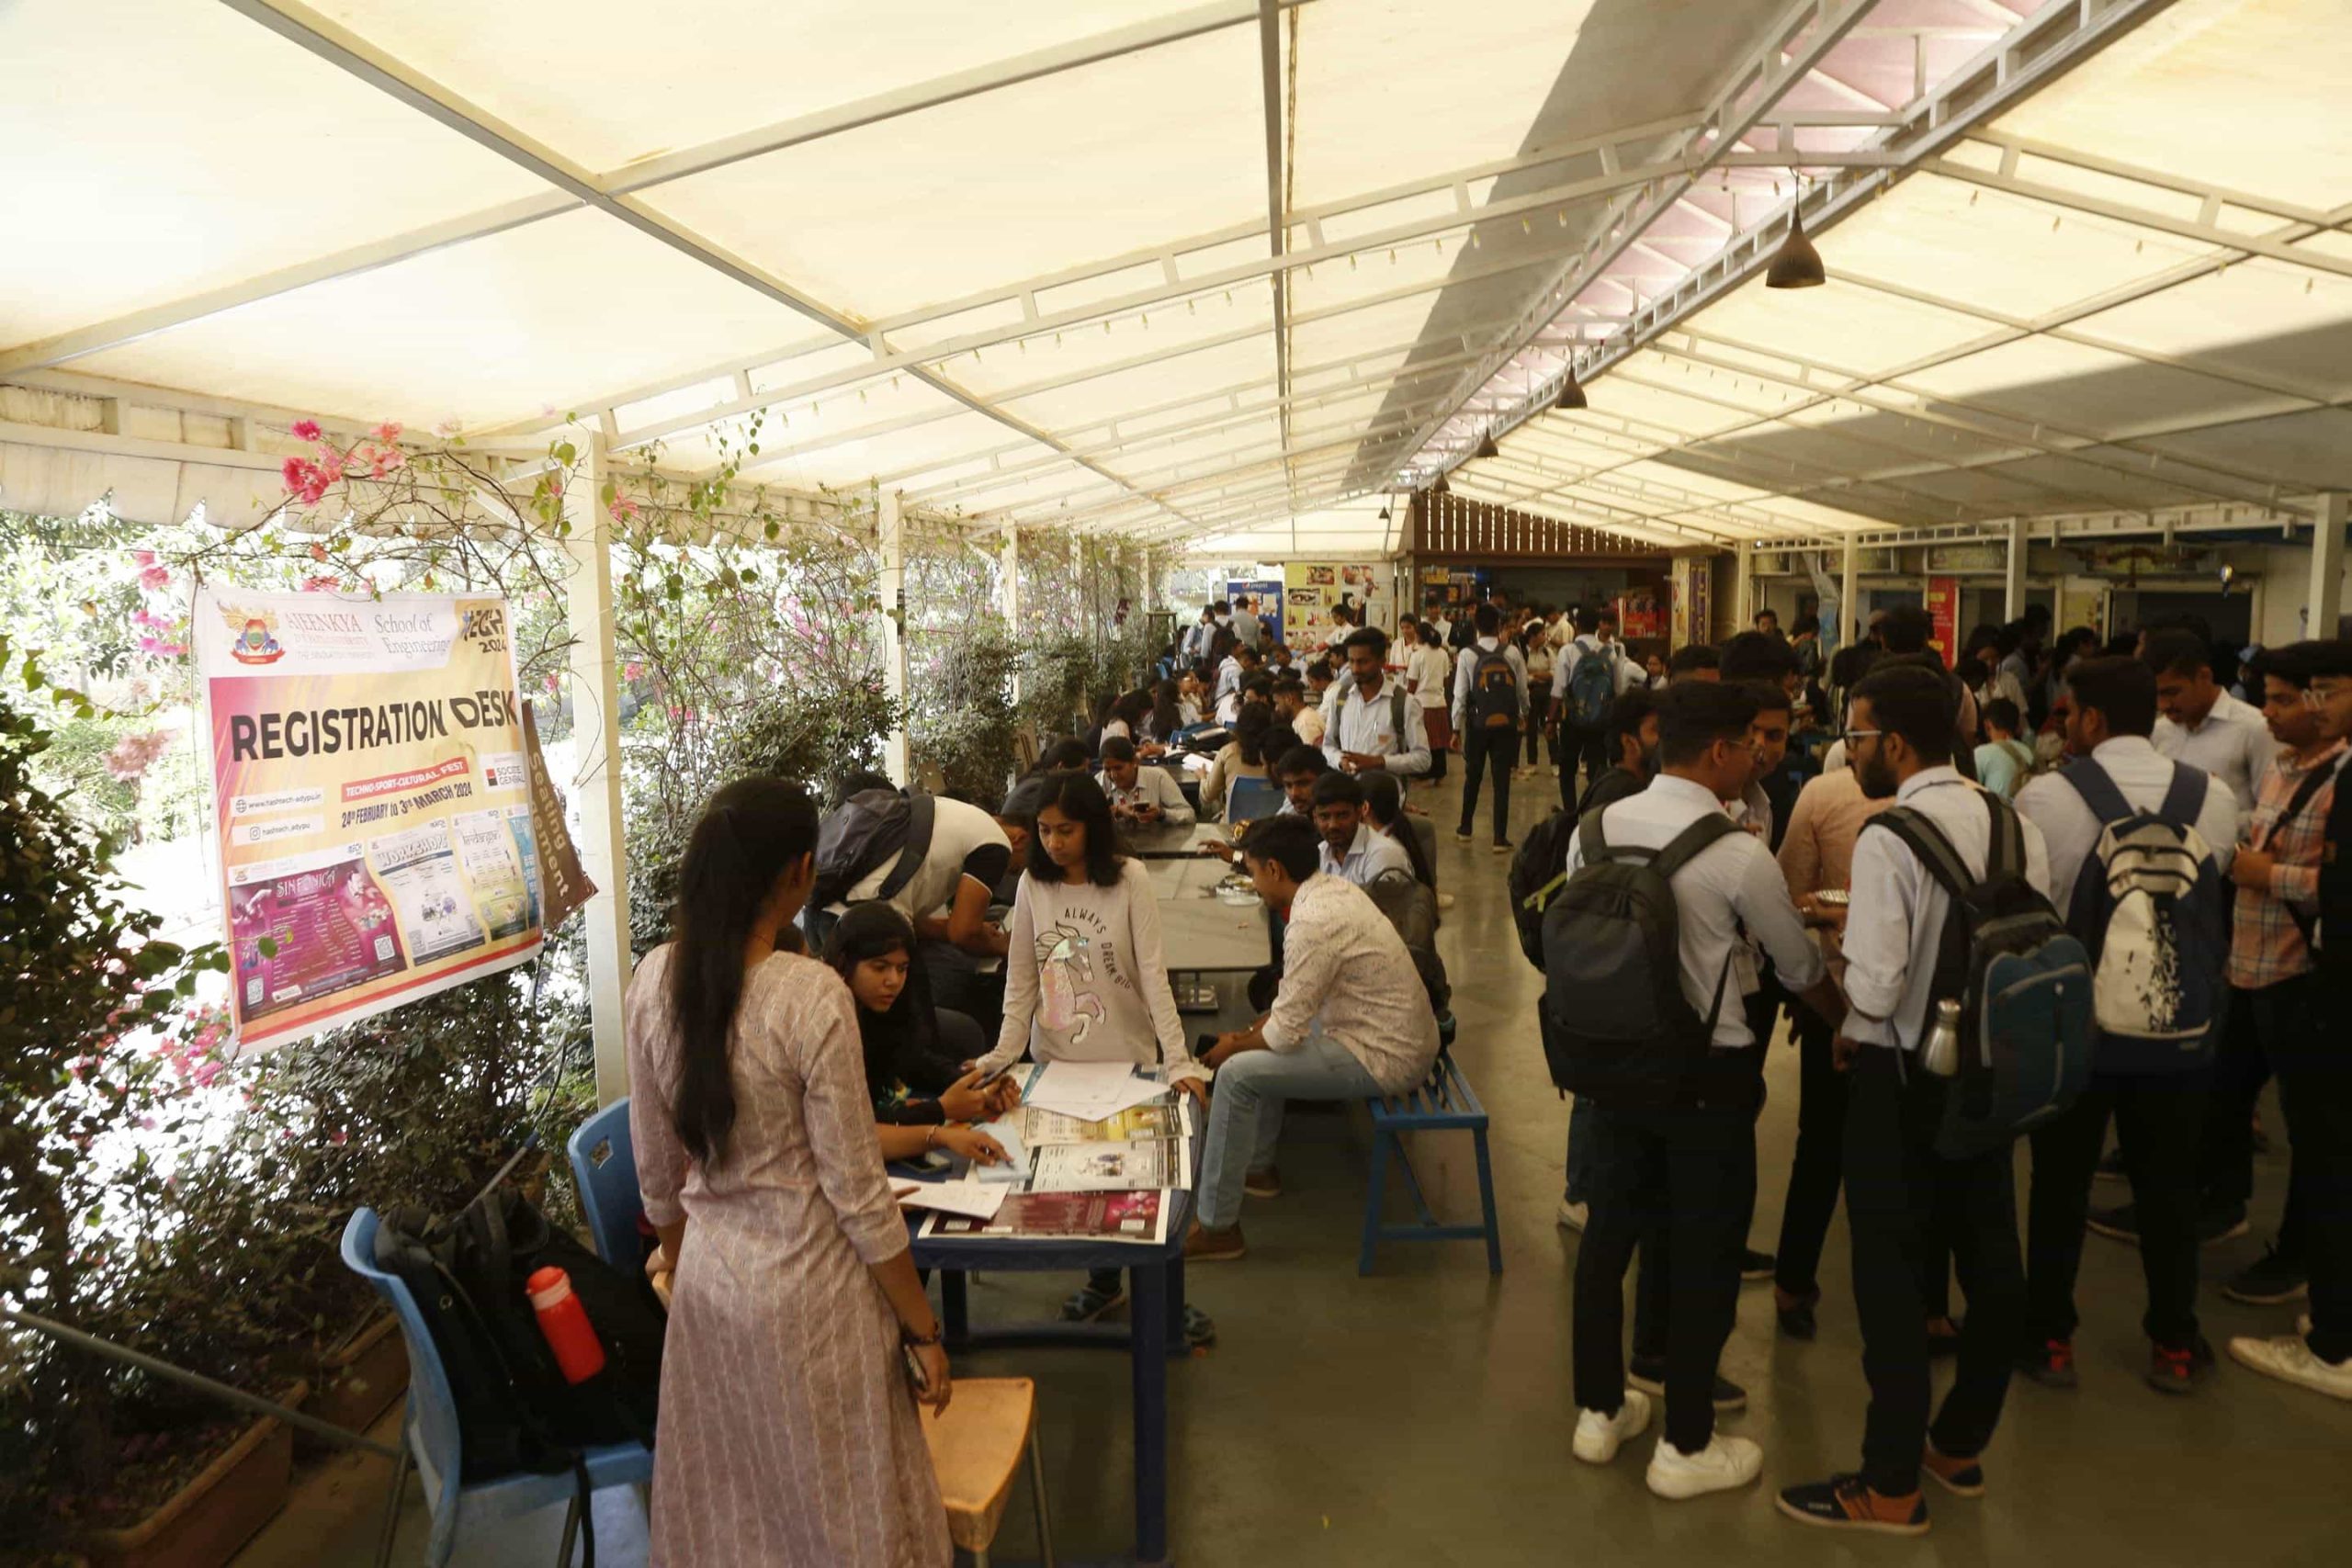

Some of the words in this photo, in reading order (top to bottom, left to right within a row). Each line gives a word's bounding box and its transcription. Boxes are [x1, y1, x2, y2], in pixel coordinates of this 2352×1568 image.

[284, 613, 363, 633] AJEENKYA
[375, 613, 417, 633] School
[418, 612, 433, 631] of
[478, 638, 507, 653] 2024
[231, 700, 448, 761] REGISTRATION
[449, 690, 518, 729] DESK
[440, 761, 464, 774] FEST
[356, 802, 388, 824] FEBRUARY
[390, 802, 399, 817] to
[413, 784, 454, 810] MARCH
[455, 781, 473, 797] 2024
[528, 751, 567, 851] Seating
[1064, 907, 1106, 934] ALWAYS
[1101, 942, 1117, 976] DREAM
[1114, 976, 1131, 989] BIG
